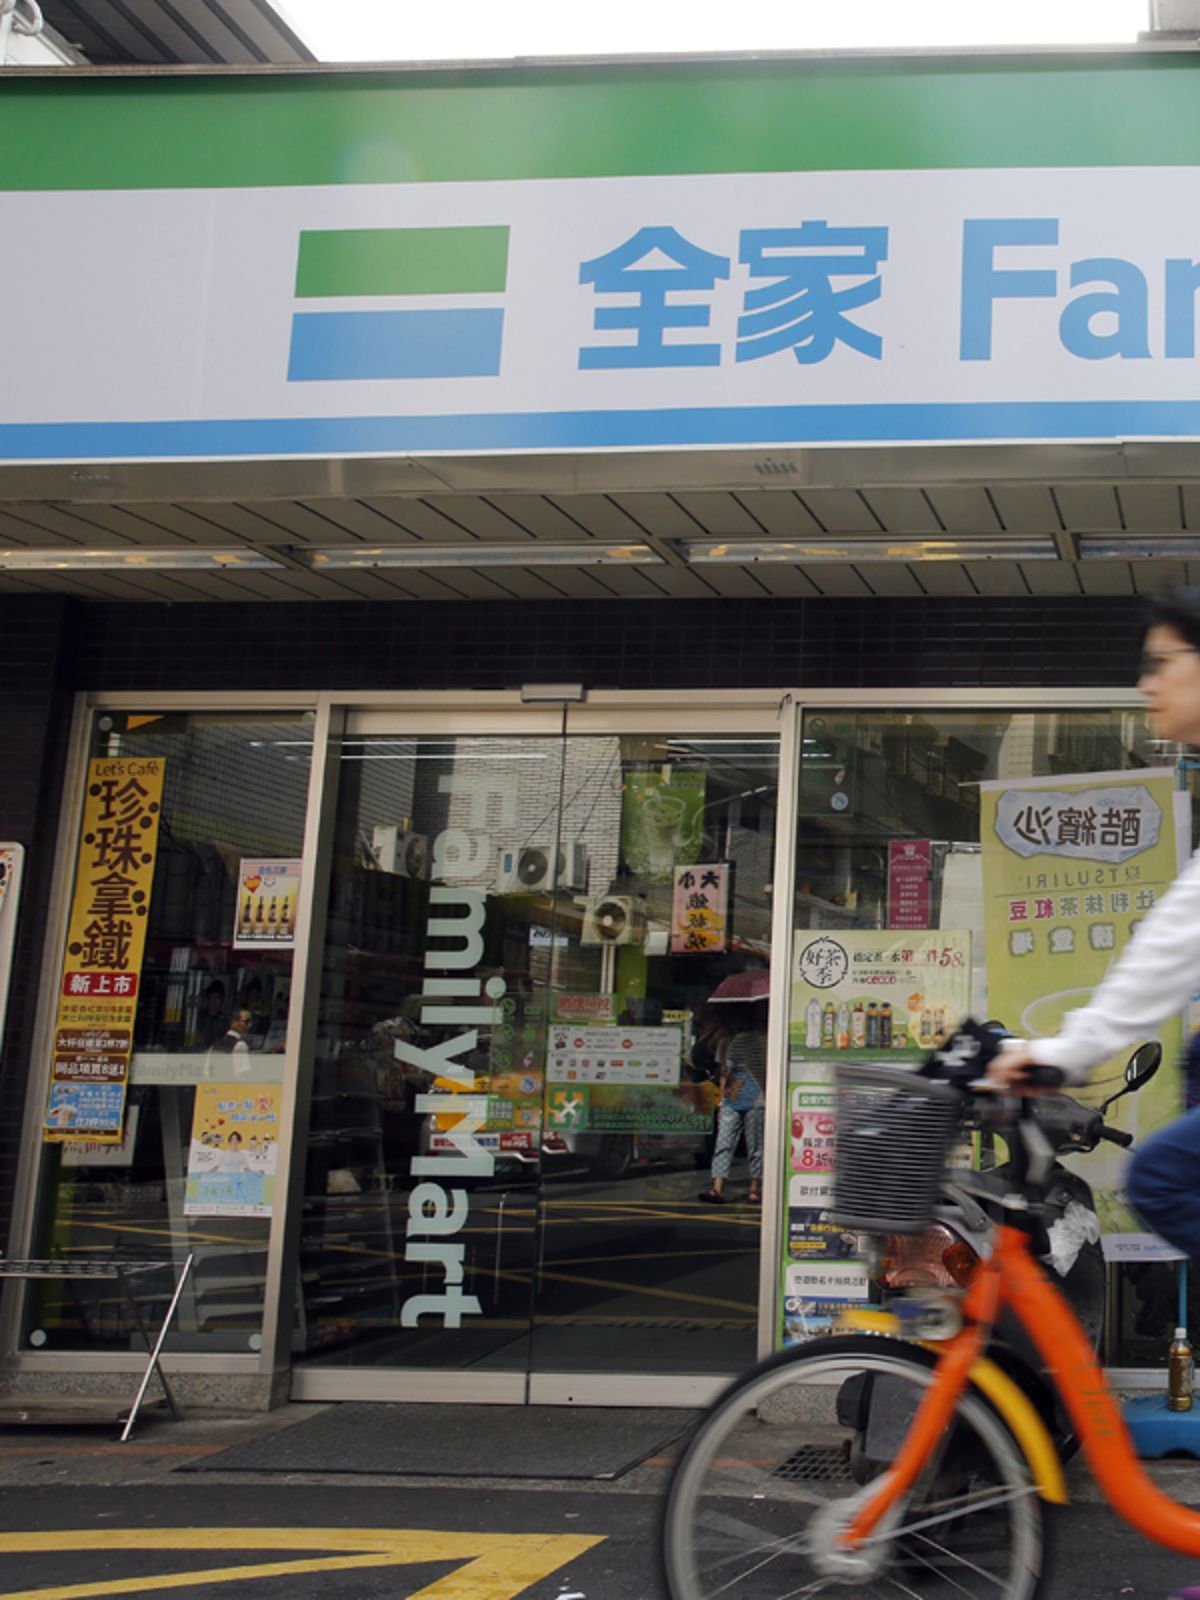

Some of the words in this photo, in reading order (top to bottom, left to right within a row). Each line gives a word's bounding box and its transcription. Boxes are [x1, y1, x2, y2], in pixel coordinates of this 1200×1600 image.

[578, 220, 890, 371] 全家
[95, 761, 124, 777] Let's
[80, 778, 149, 971] 珍珠拿鐵
[70, 974, 133, 996] 新上市
[395, 774, 518, 1329] FamilyMart
